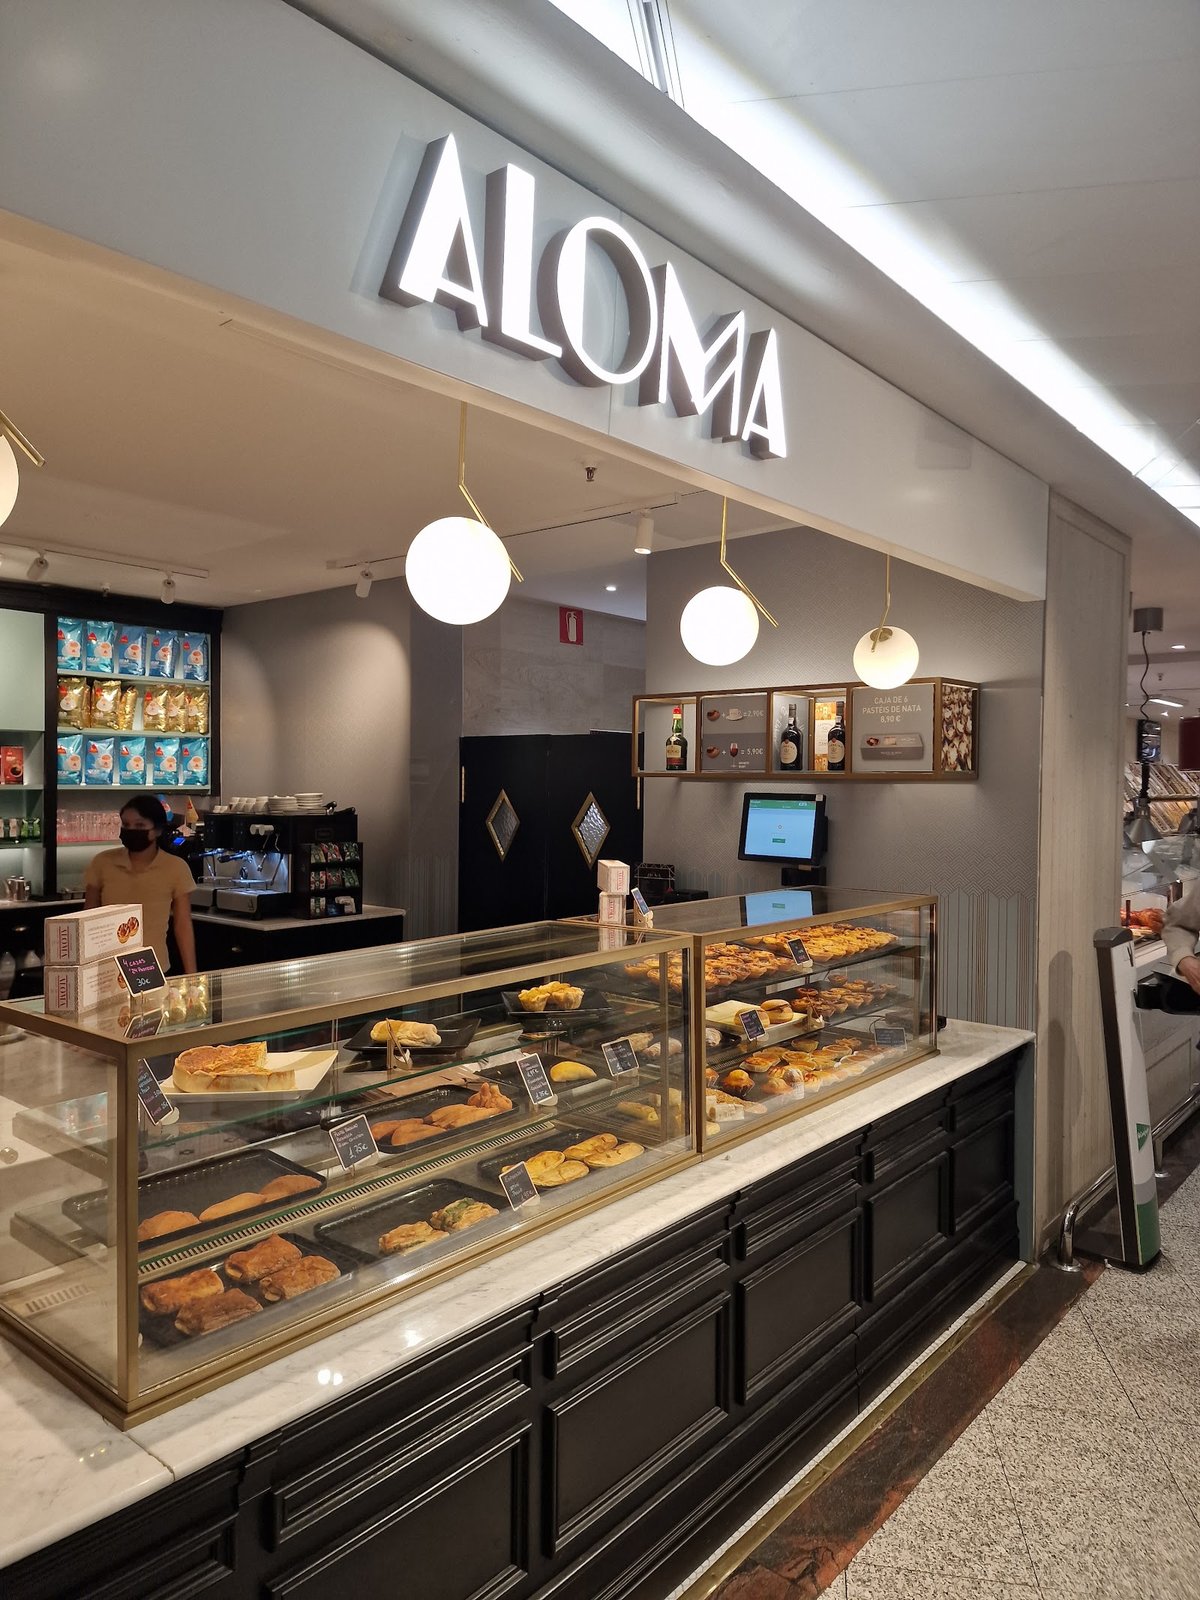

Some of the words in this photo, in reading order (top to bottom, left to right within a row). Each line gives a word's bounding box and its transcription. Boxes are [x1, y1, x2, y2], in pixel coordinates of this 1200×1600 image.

[384, 131, 787, 459] ALOMA
[874, 696, 891, 705] CAJA
[892, 695, 902, 704] DE
[903, 695, 908, 703] 6
[891, 705, 900, 713] DE
[901, 704, 921, 713] NATA
[122, 959, 129, 967] 4
[136, 977, 151, 987] 30€
